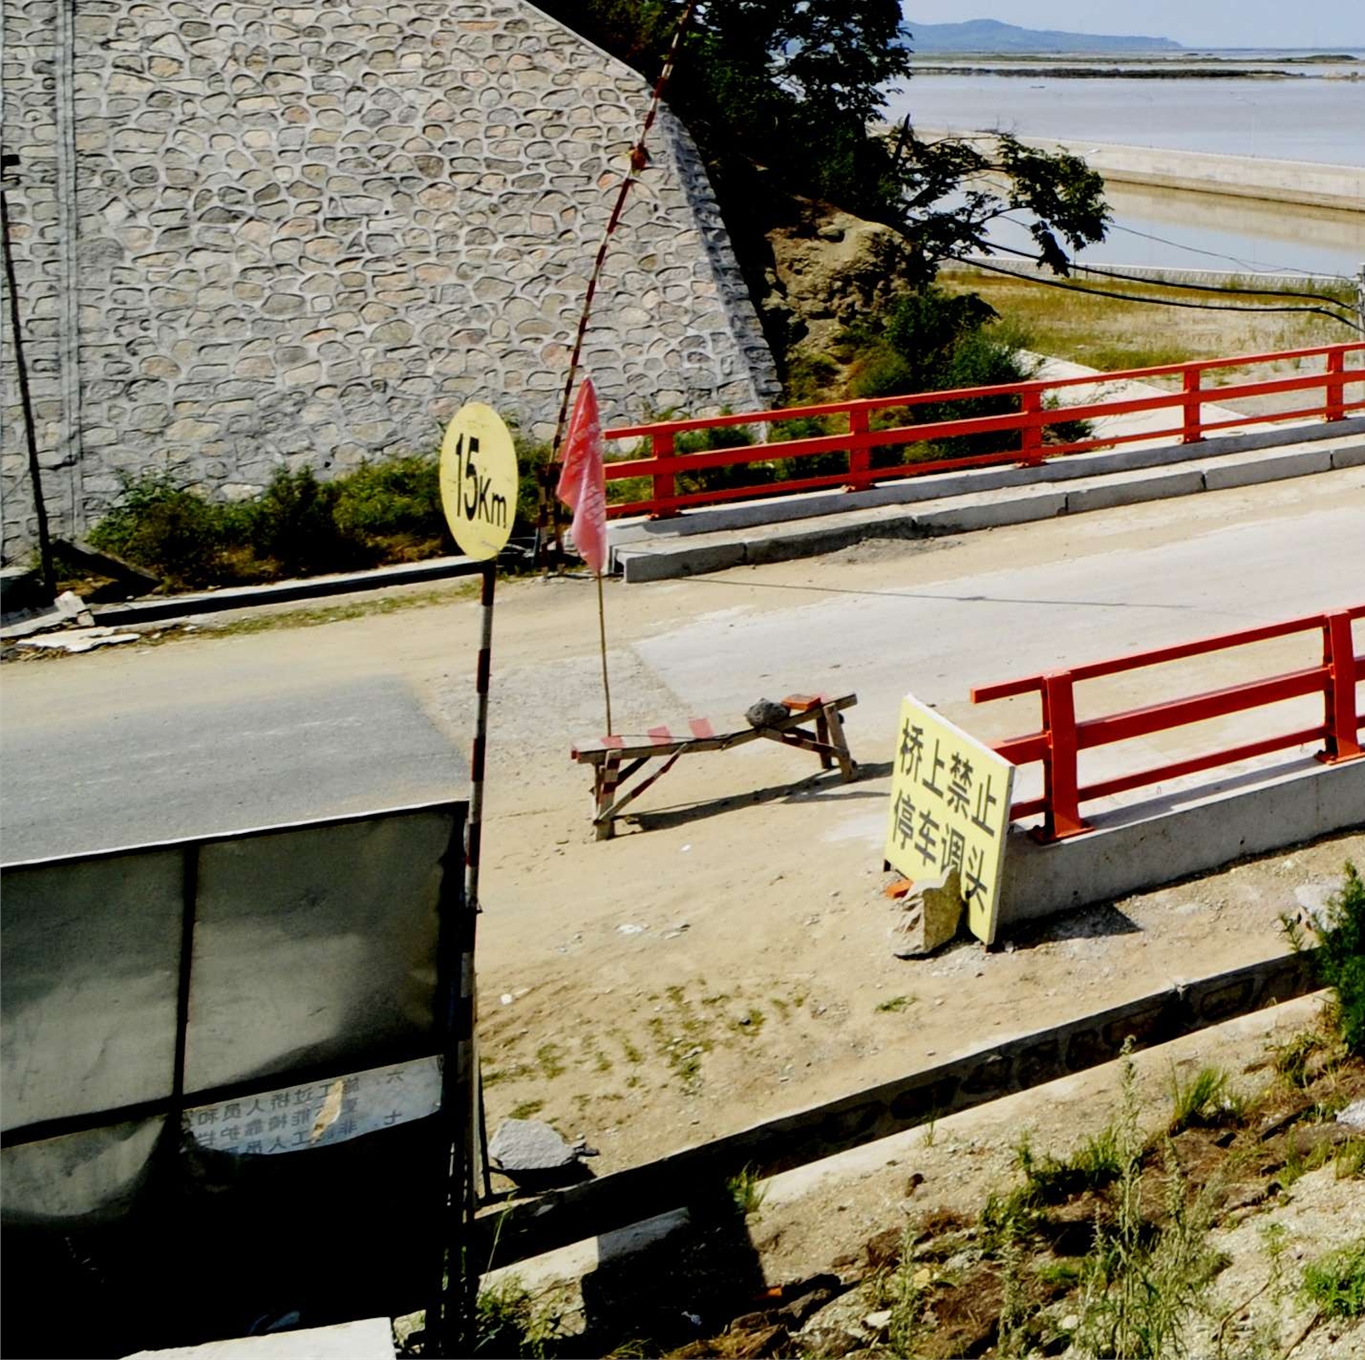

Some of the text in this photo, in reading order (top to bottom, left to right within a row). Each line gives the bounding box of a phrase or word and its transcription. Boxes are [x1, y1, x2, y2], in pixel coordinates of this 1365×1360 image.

[899, 717, 998, 838] 桥上禁止
[892, 789, 990, 913] 停车调头
